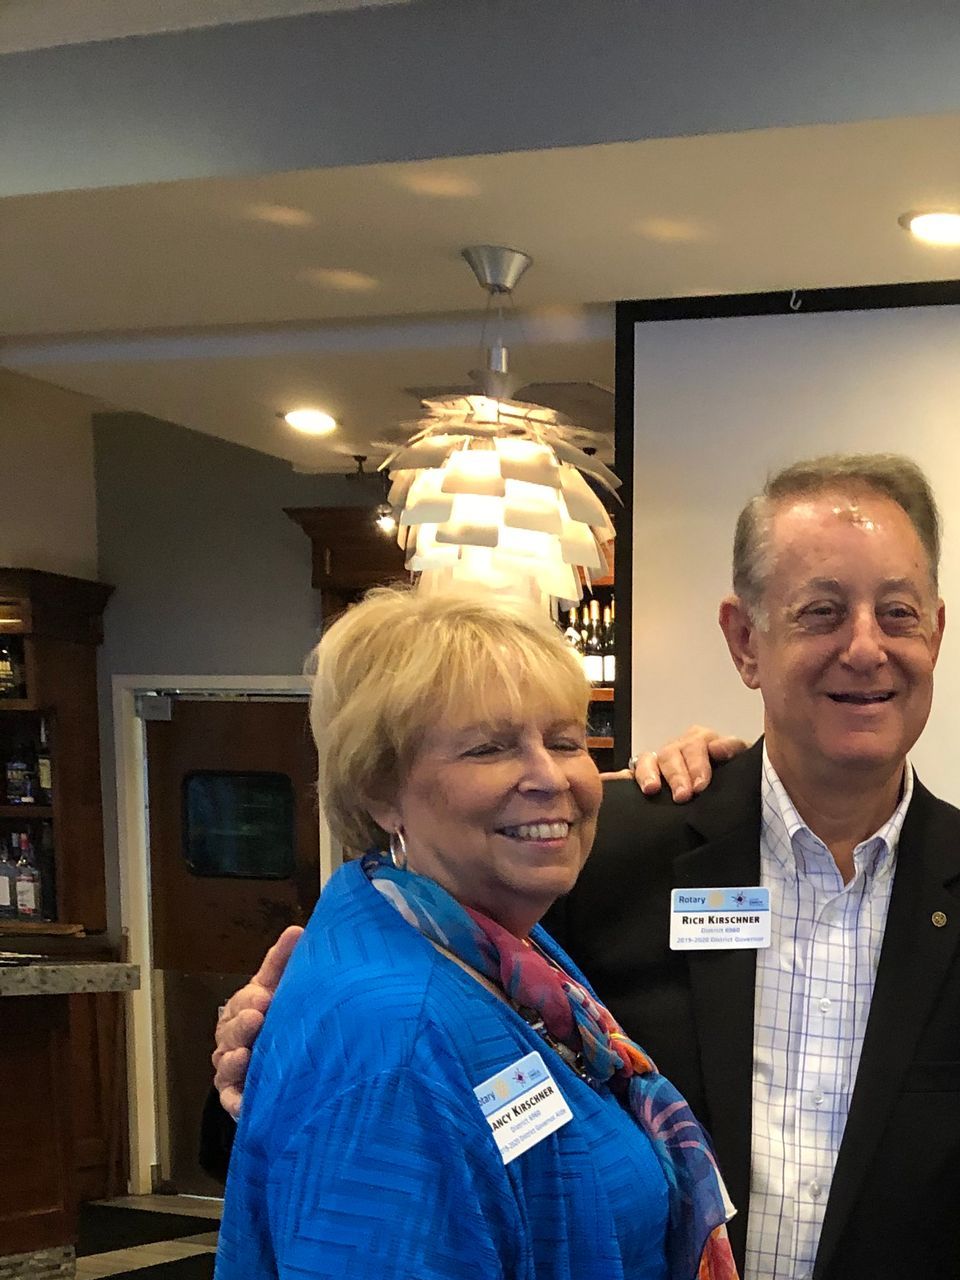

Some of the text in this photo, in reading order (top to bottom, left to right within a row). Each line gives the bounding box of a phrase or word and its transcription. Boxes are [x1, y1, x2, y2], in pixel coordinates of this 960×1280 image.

[679, 895, 706, 905] Rotary
[708, 916, 760, 925] KIRSCHNER
[491, 1111, 512, 1131] ANCY
